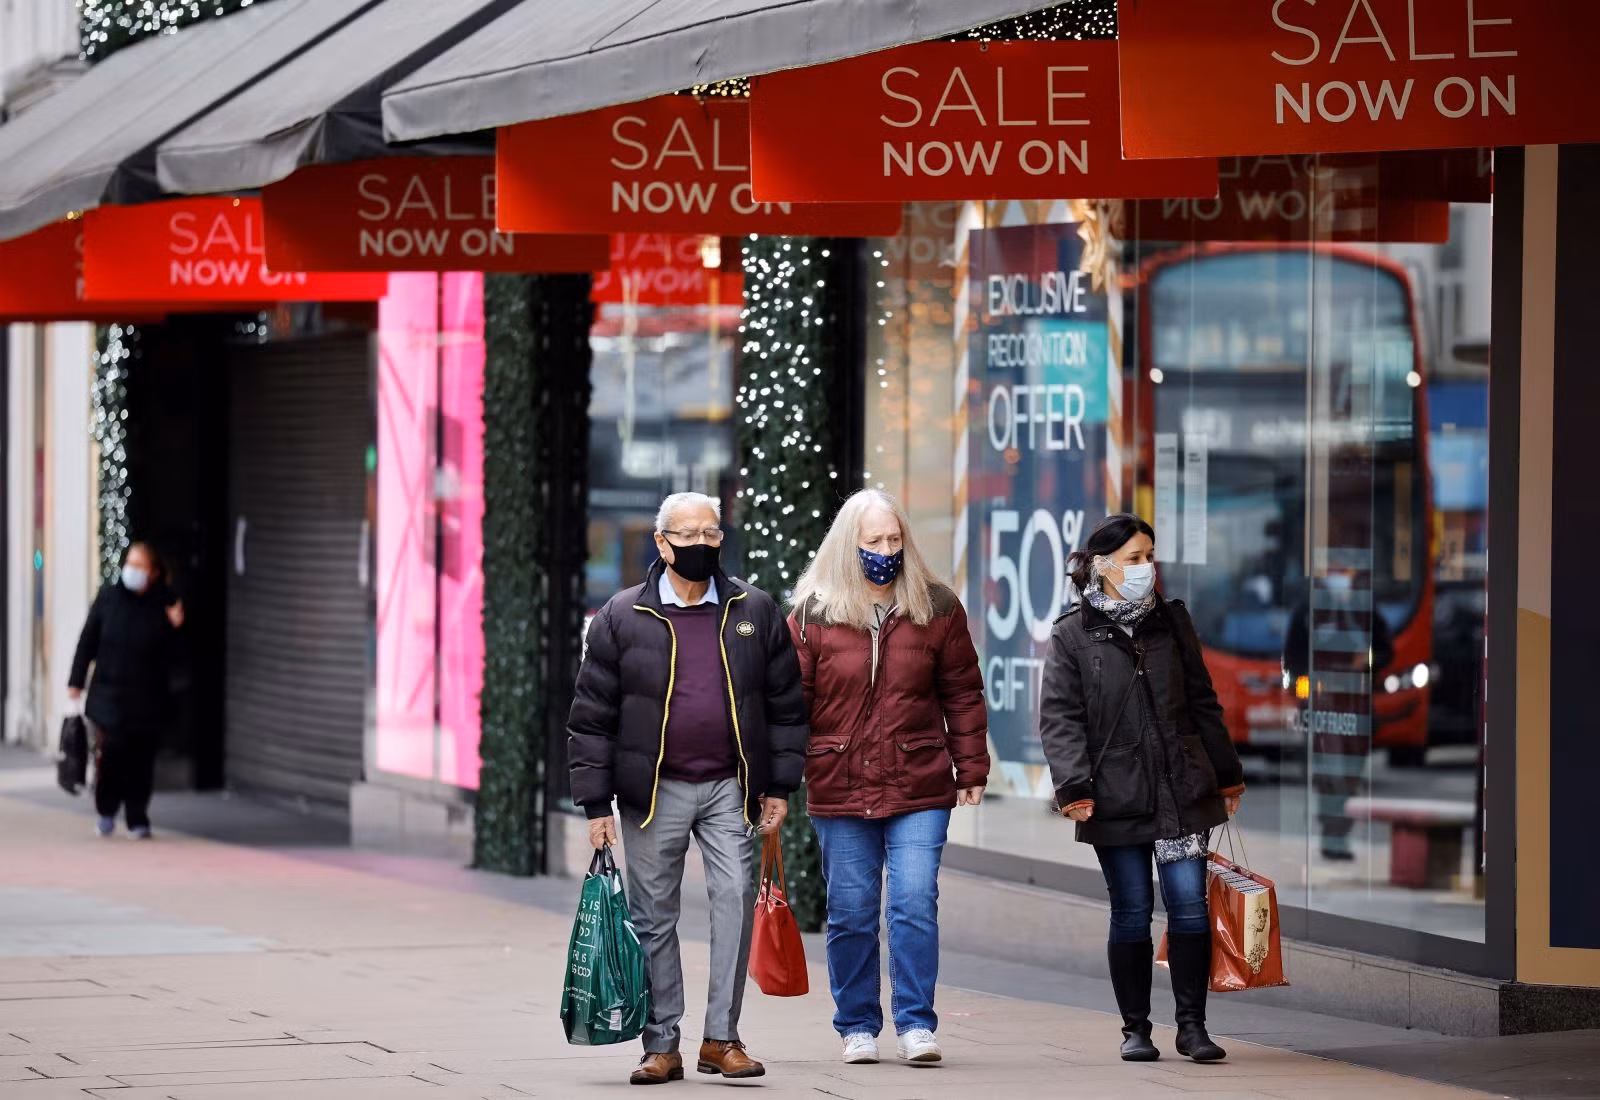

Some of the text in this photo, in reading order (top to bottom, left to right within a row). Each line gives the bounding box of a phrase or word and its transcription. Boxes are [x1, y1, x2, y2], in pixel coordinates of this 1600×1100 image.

[1271, 0, 1518, 66] SALE
[880, 66, 1091, 127] SALE
[1275, 74, 1517, 124] NOW ON
[610, 116, 749, 171] SAL
[882, 140, 1089, 177] NOW ON
[611, 181, 718, 214] NOW
[169, 212, 265, 254] SAL
[360, 228, 514, 257] NOW ON
[169, 259, 251, 286] NOW
[987, 270, 1088, 316] EXCLUSIVE
[987, 331, 1088, 368] RECOGNITION
[987, 384, 1086, 452] OFFER
